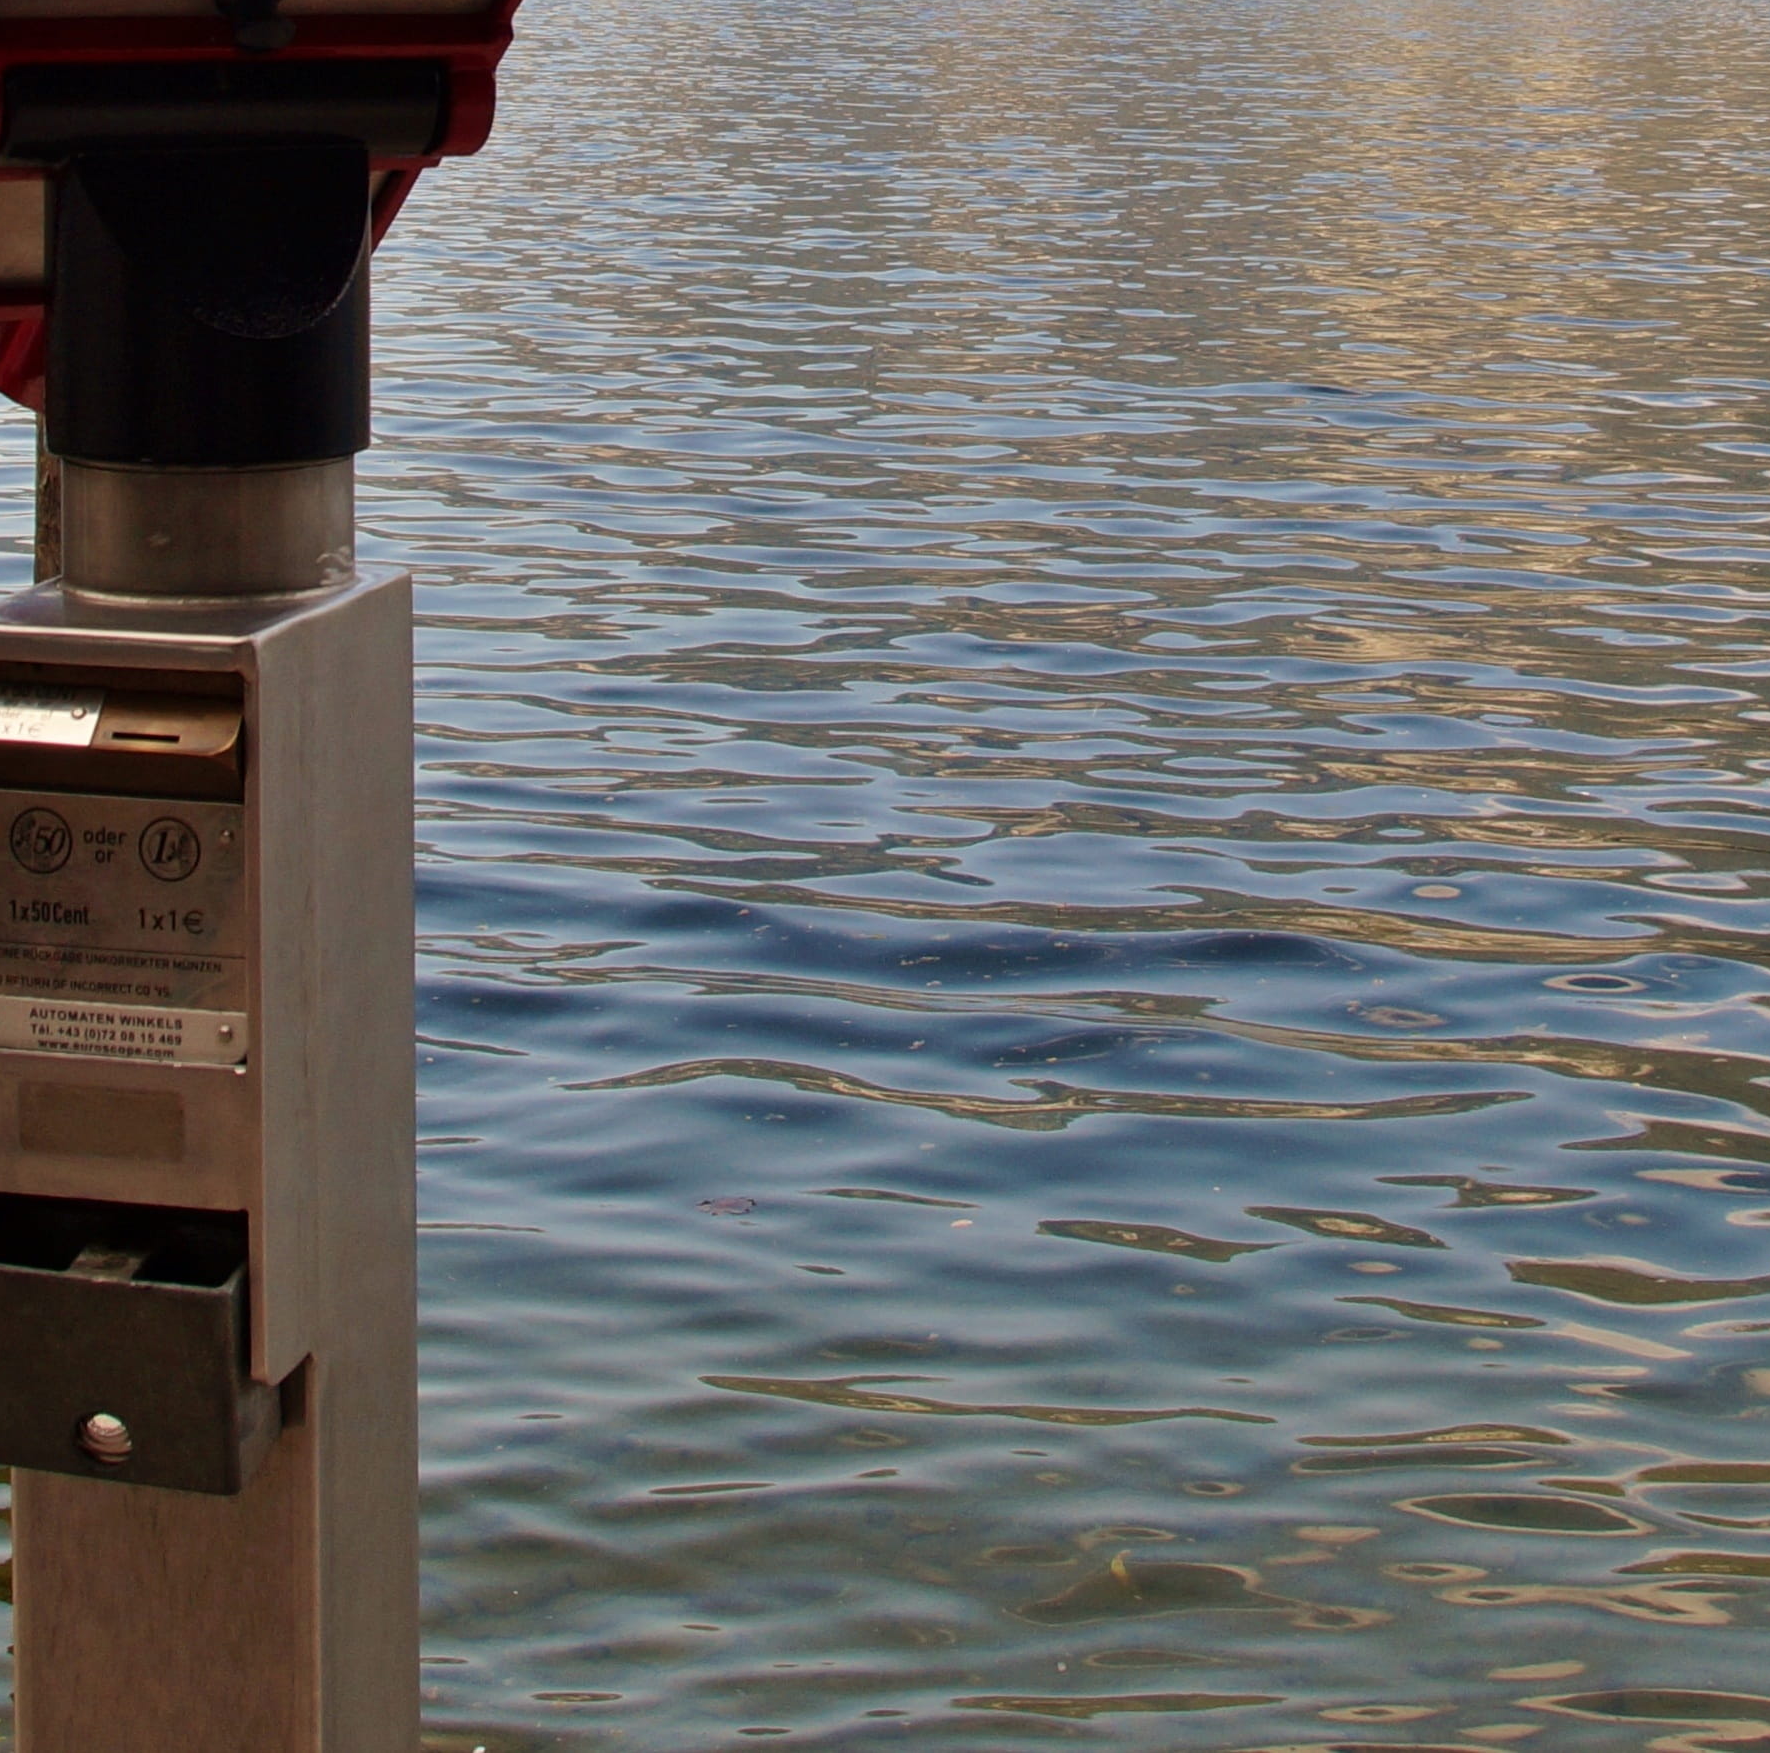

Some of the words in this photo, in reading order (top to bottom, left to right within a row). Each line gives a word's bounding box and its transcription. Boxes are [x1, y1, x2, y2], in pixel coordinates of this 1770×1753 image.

[83, 827, 127, 845] oder
[95, 849, 114, 863] or
[5, 975, 50, 989] RETURN
[30, 1008, 114, 1024] AUTOMATEN
[119, 1016, 182, 1030] WINKELS
[58, 1027, 80, 1037] +43
[84, 1028, 116, 1042] (0)72
[120, 1031, 135, 1043] 08
[140, 1032, 154, 1044] 15
[159, 1034, 182, 1046] 469
[38, 1040, 174, 1058] www.euroscope.com
